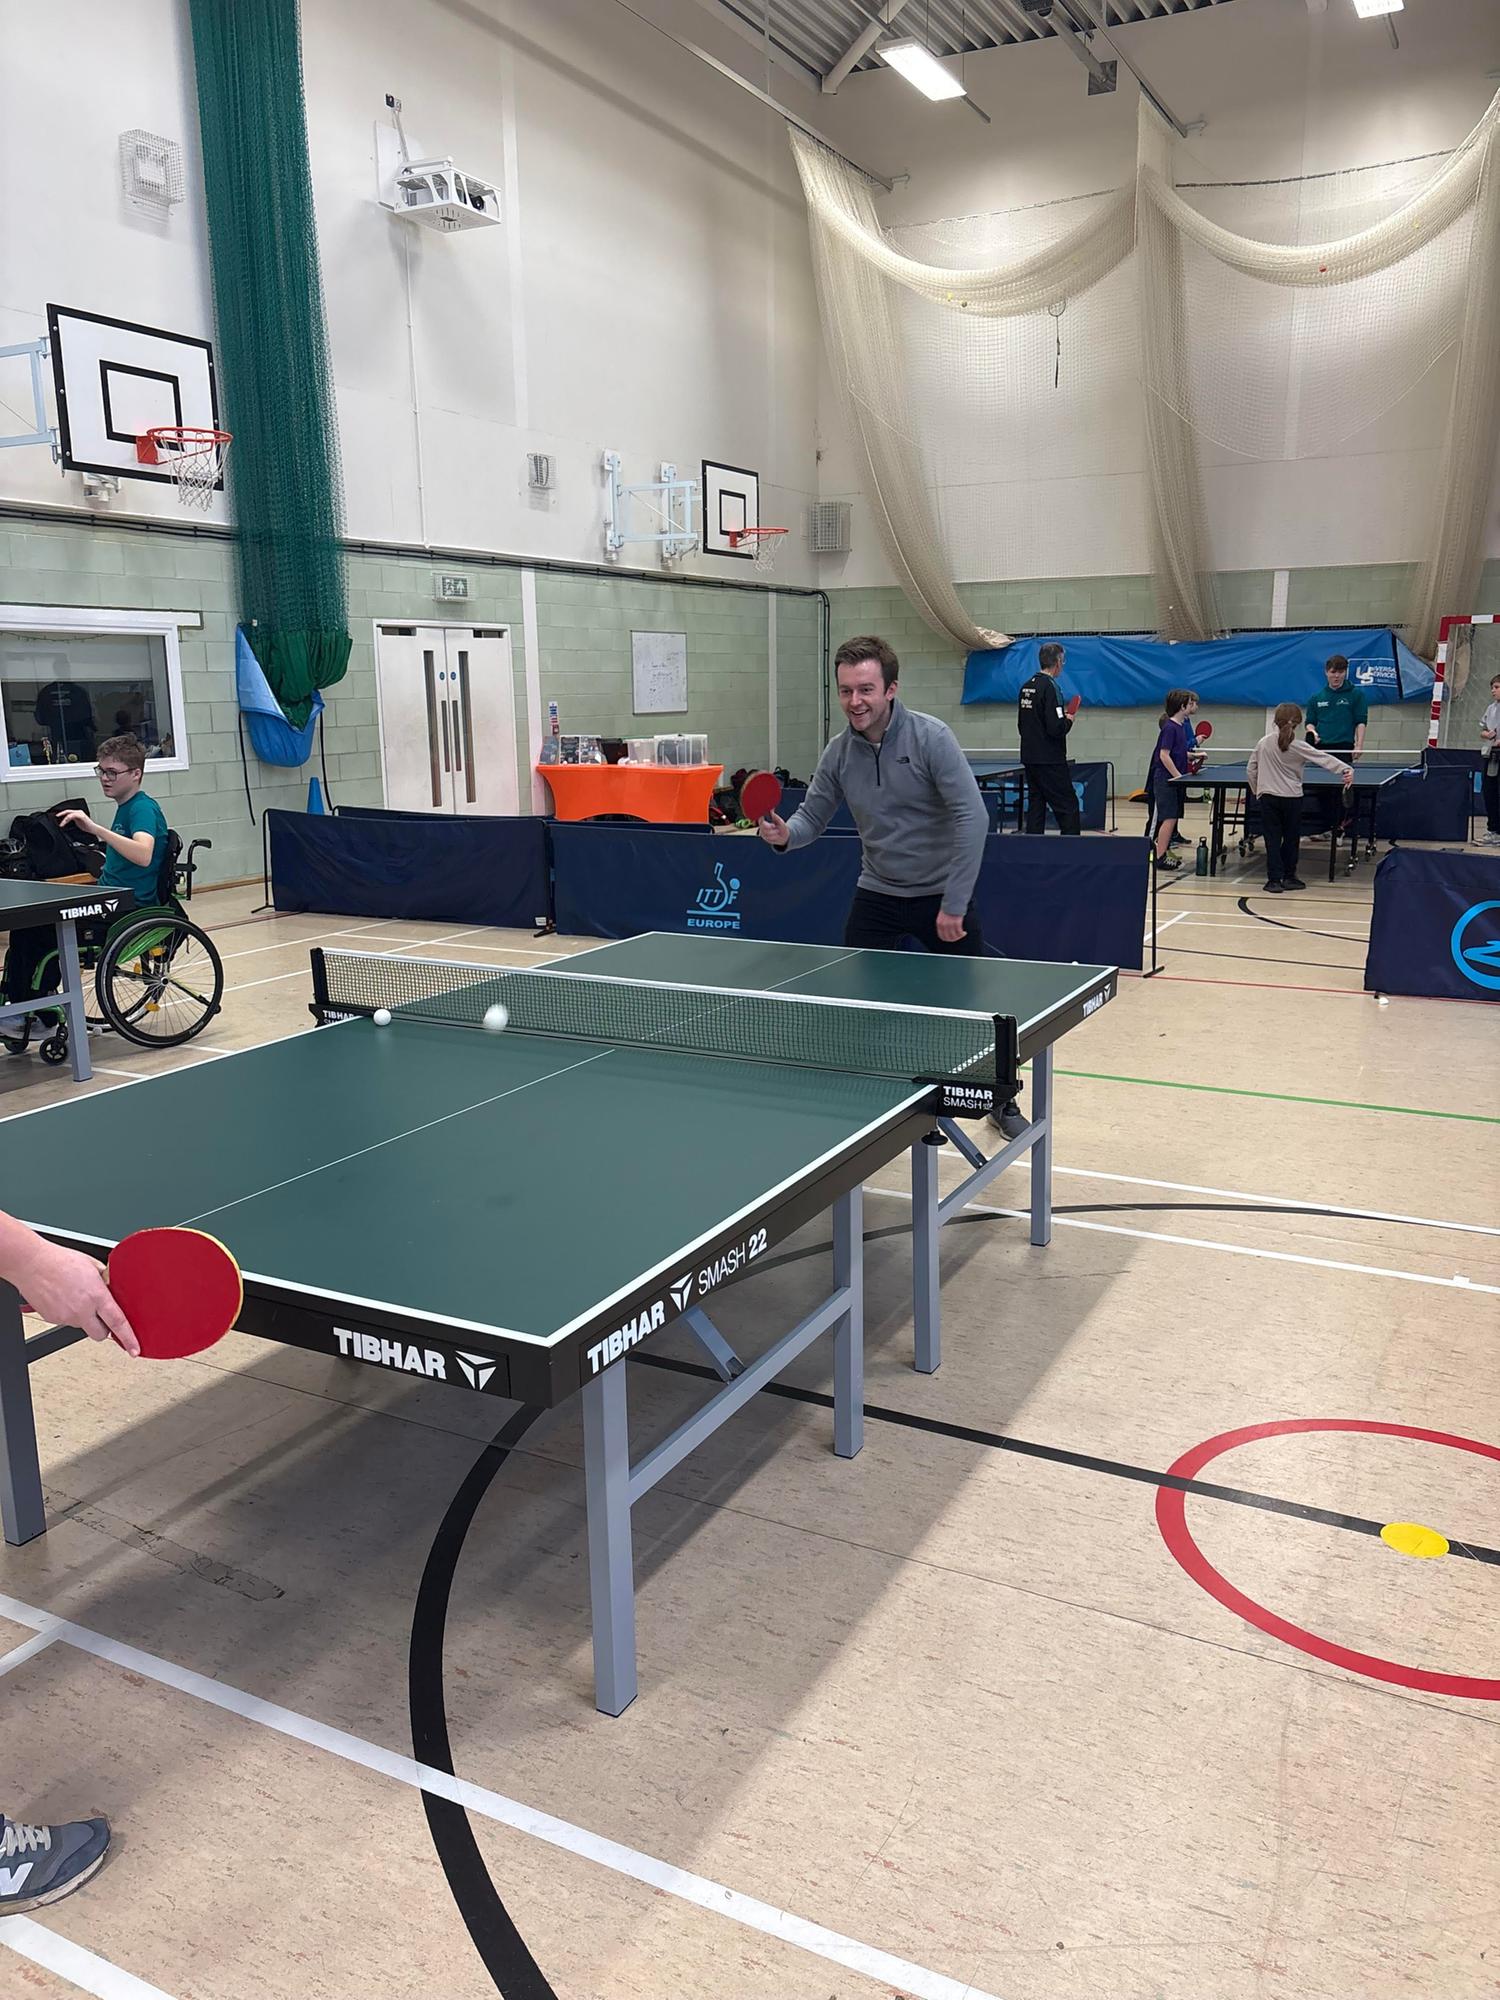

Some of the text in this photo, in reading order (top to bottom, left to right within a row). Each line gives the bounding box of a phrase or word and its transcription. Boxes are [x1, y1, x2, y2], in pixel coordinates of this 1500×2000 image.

[696, 888, 739, 905] ITTF
[60, 904, 103, 920] TIBHAR
[687, 918, 741, 930] EUROPE
[1083, 992, 1104, 1018] TIBHAR
[943, 1085, 993, 1100] TIBHAR
[943, 1096, 982, 1110] SMASH
[587, 1228, 767, 1374] TIBHAR SMASH 22
[333, 1327, 447, 1379] TIBHAR
